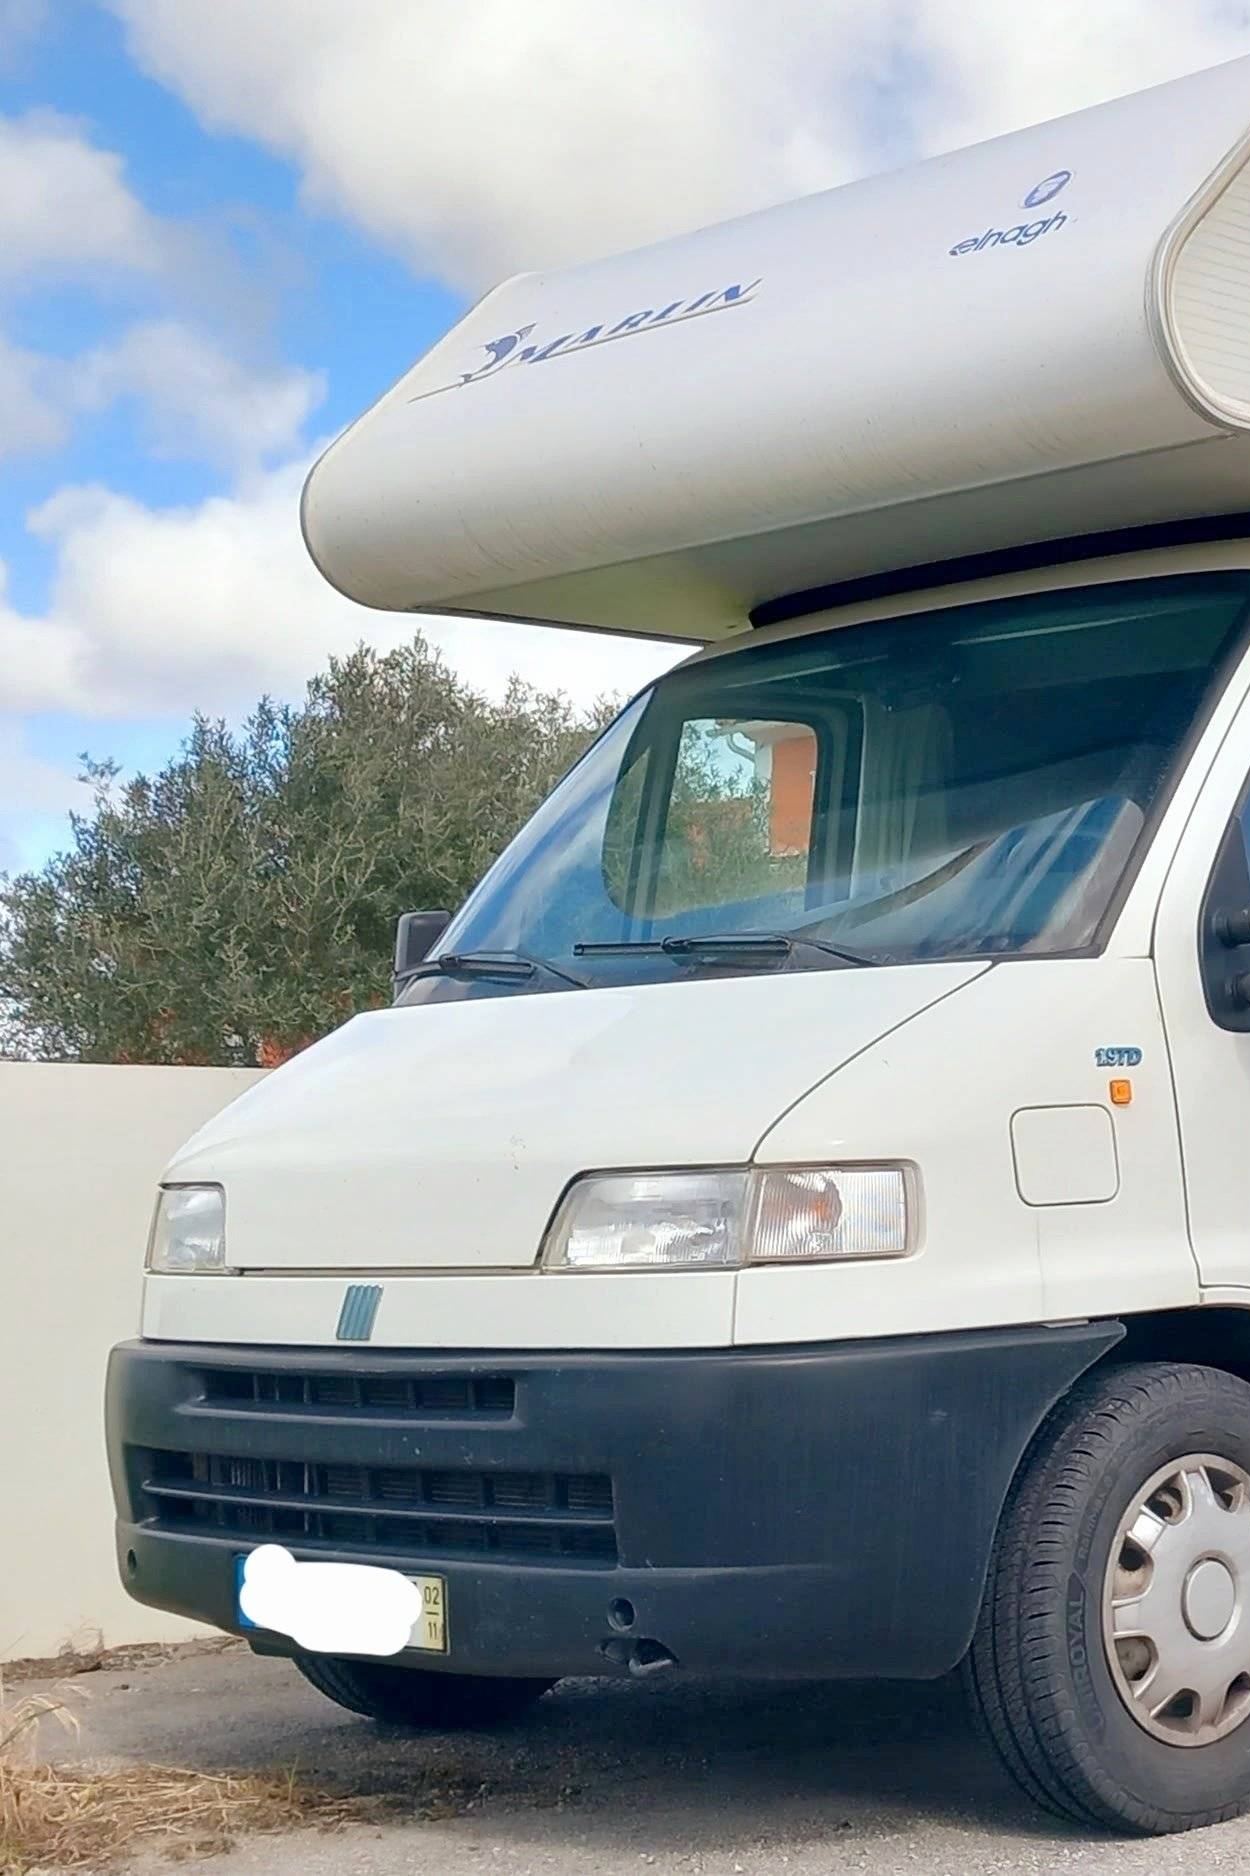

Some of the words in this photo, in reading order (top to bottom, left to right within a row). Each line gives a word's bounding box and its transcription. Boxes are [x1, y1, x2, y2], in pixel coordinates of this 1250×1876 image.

[950, 210, 1068, 257] elnagh
[518, 278, 763, 364] MARLIN
[424, 1585, 440, 1605] 02
[427, 1621, 438, 1640] 11
